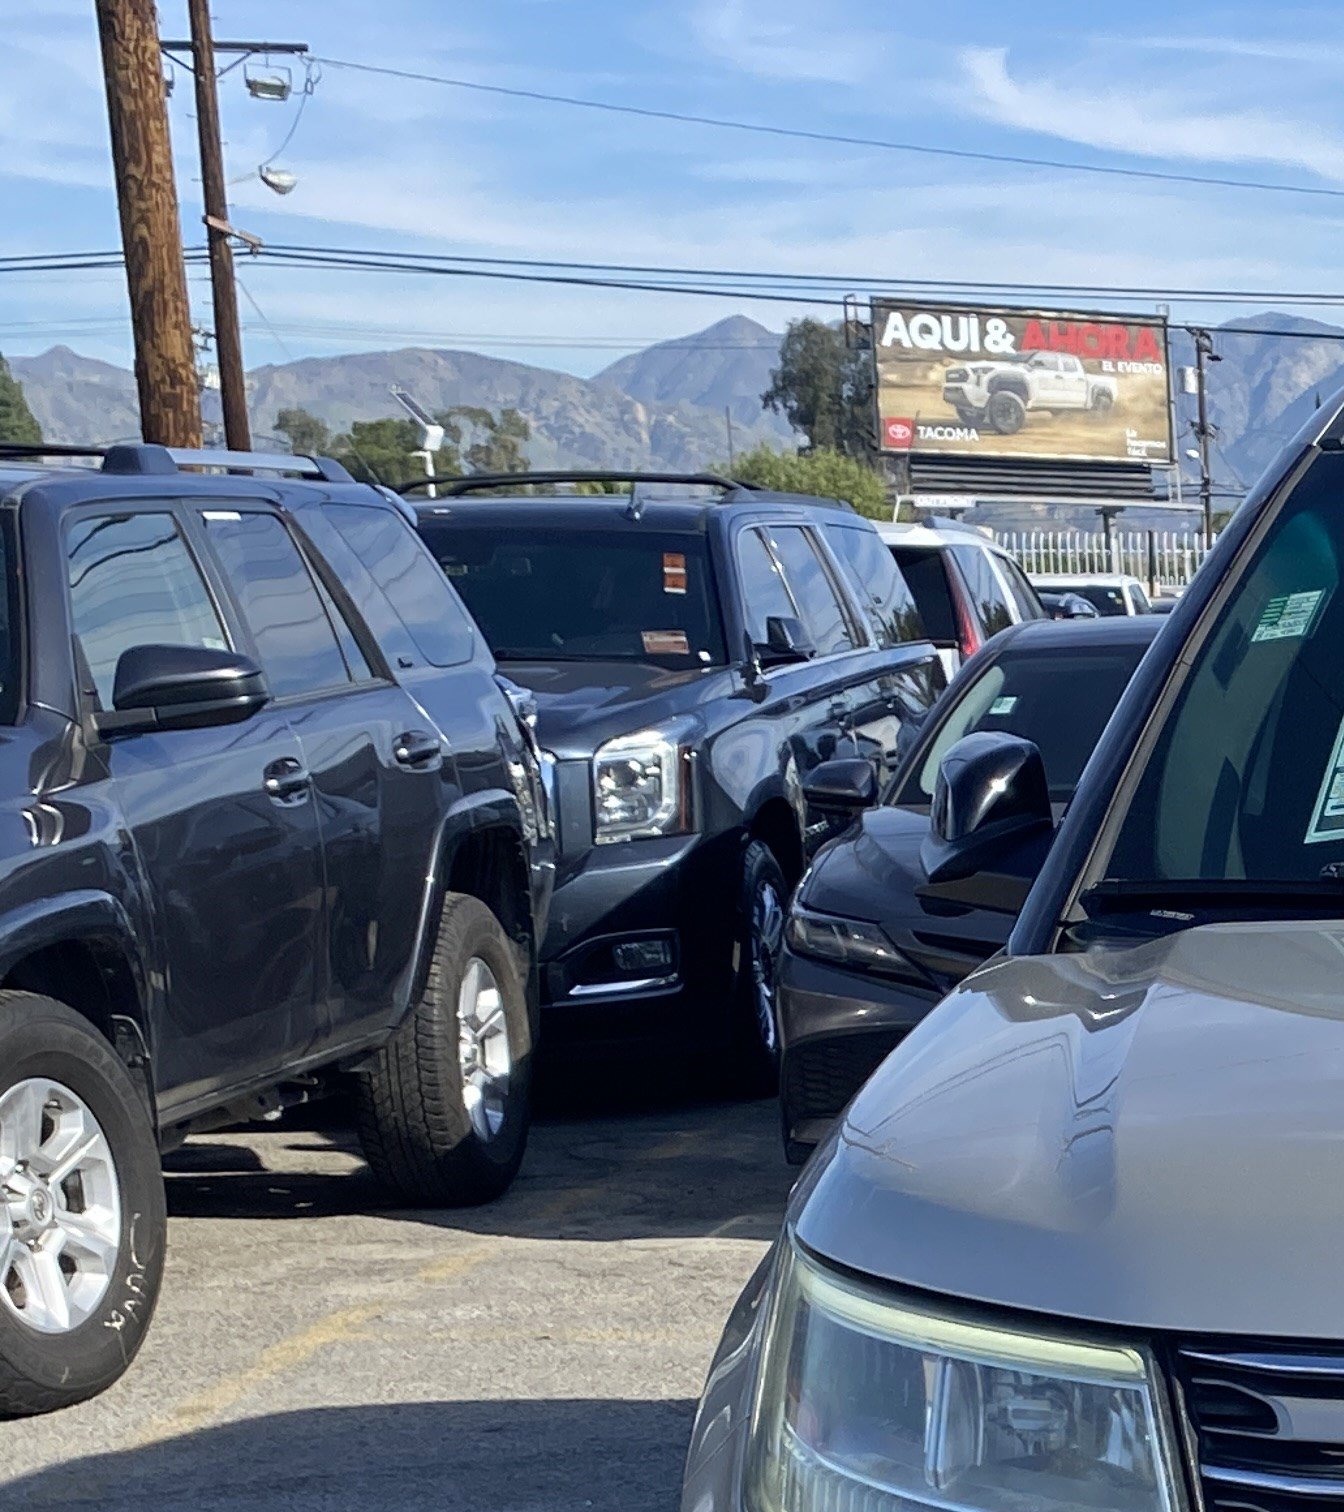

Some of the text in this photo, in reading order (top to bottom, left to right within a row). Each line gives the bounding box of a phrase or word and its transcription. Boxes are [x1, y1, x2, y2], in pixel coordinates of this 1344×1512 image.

[983, 318, 1017, 354] &
[1020, 319, 1162, 363] AHORA
[1101, 360, 1163, 375] EL EVENTO
[916, 425, 980, 442] TACOMA
